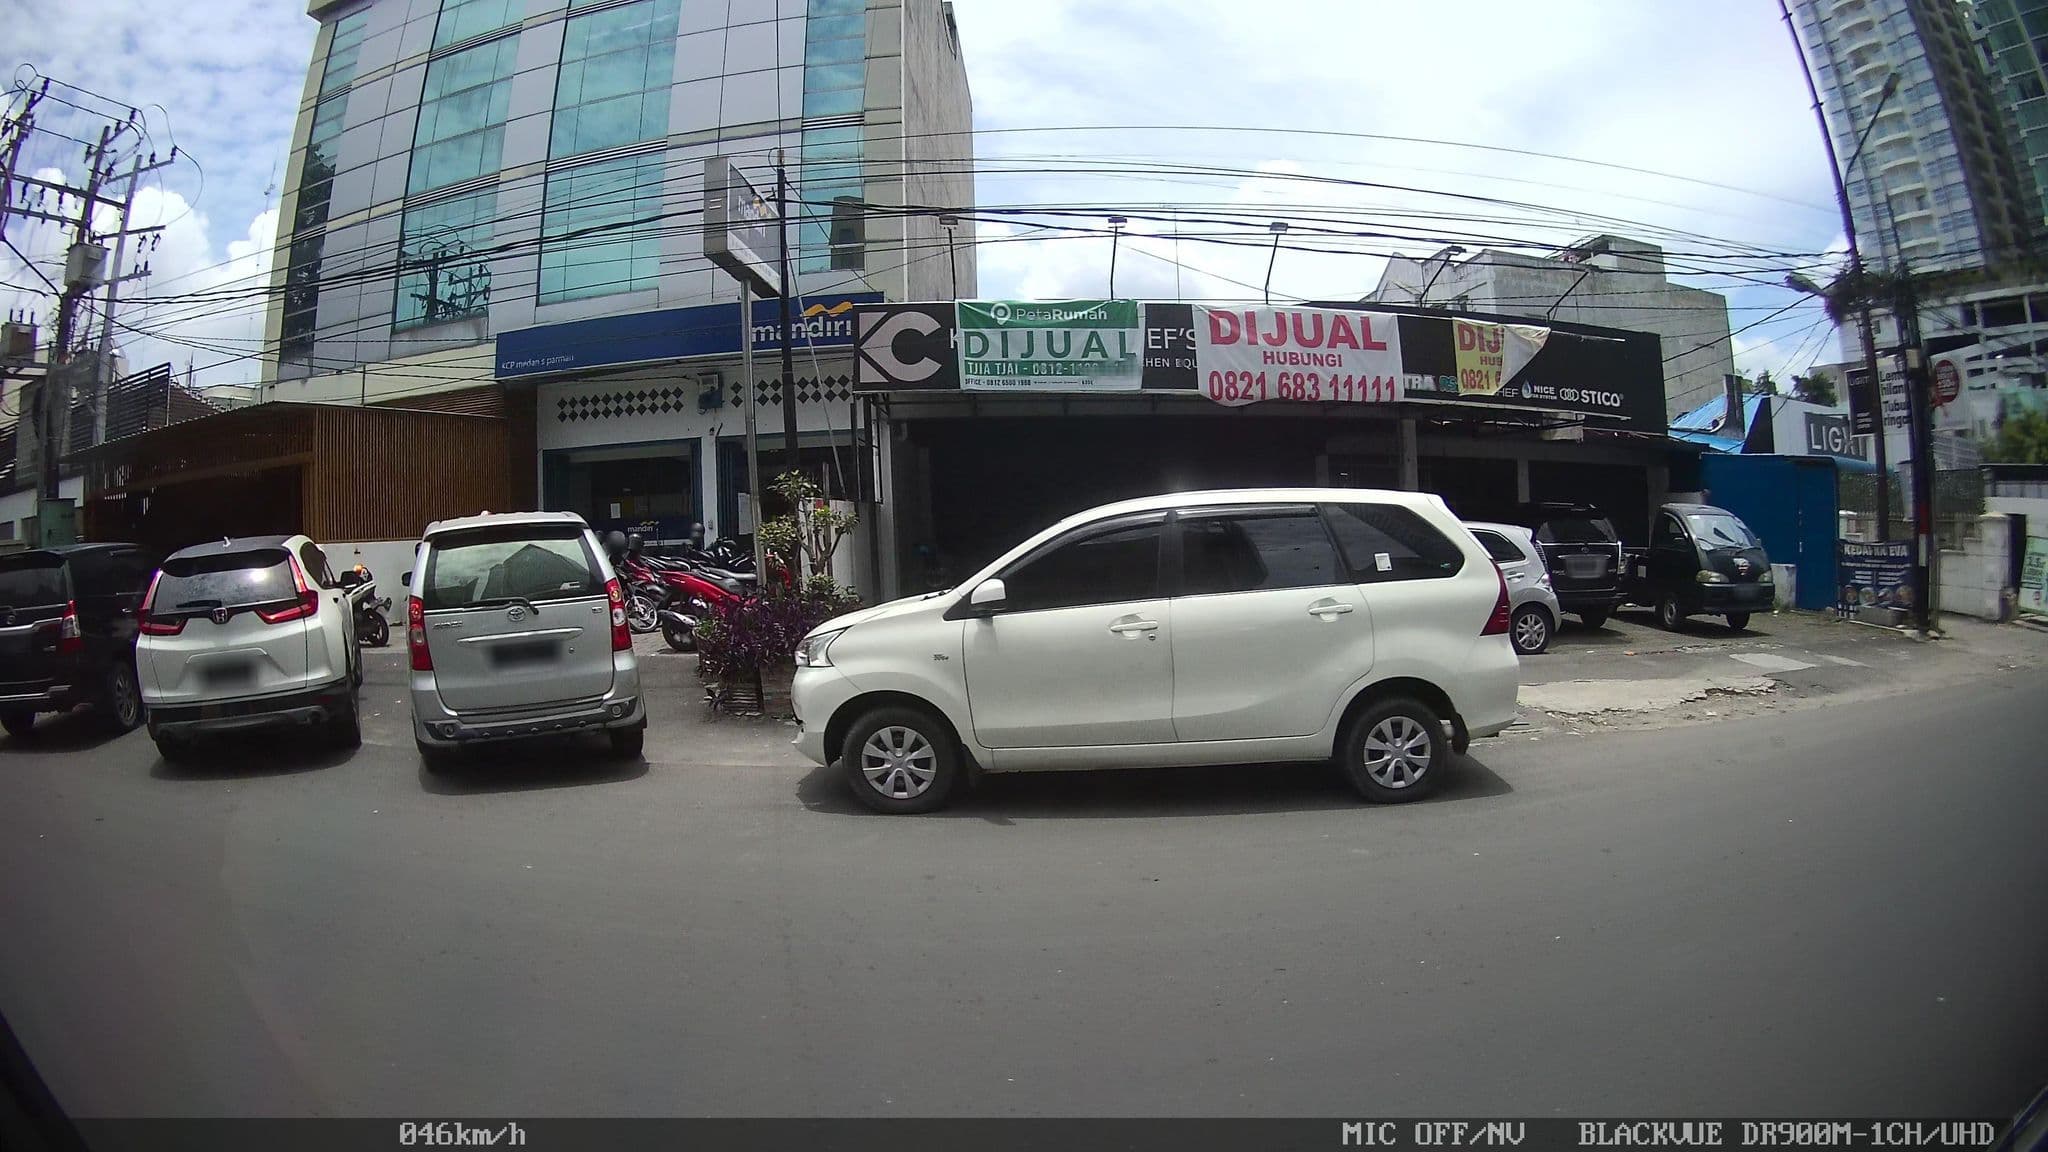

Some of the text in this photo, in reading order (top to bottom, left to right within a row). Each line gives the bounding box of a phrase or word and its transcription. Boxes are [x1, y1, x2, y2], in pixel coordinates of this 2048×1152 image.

[1016, 308, 1108, 321] PetaRumah
[1208, 310, 1387, 351] DIJUAL
[964, 331, 1137, 359] DIJUAL
[1263, 351, 1343, 367] HUBUNGI
[967, 362, 991, 375] TJIA
[1208, 371, 1396, 403] 0821 683 11111
[1533, 385, 1555, 395] NICE
